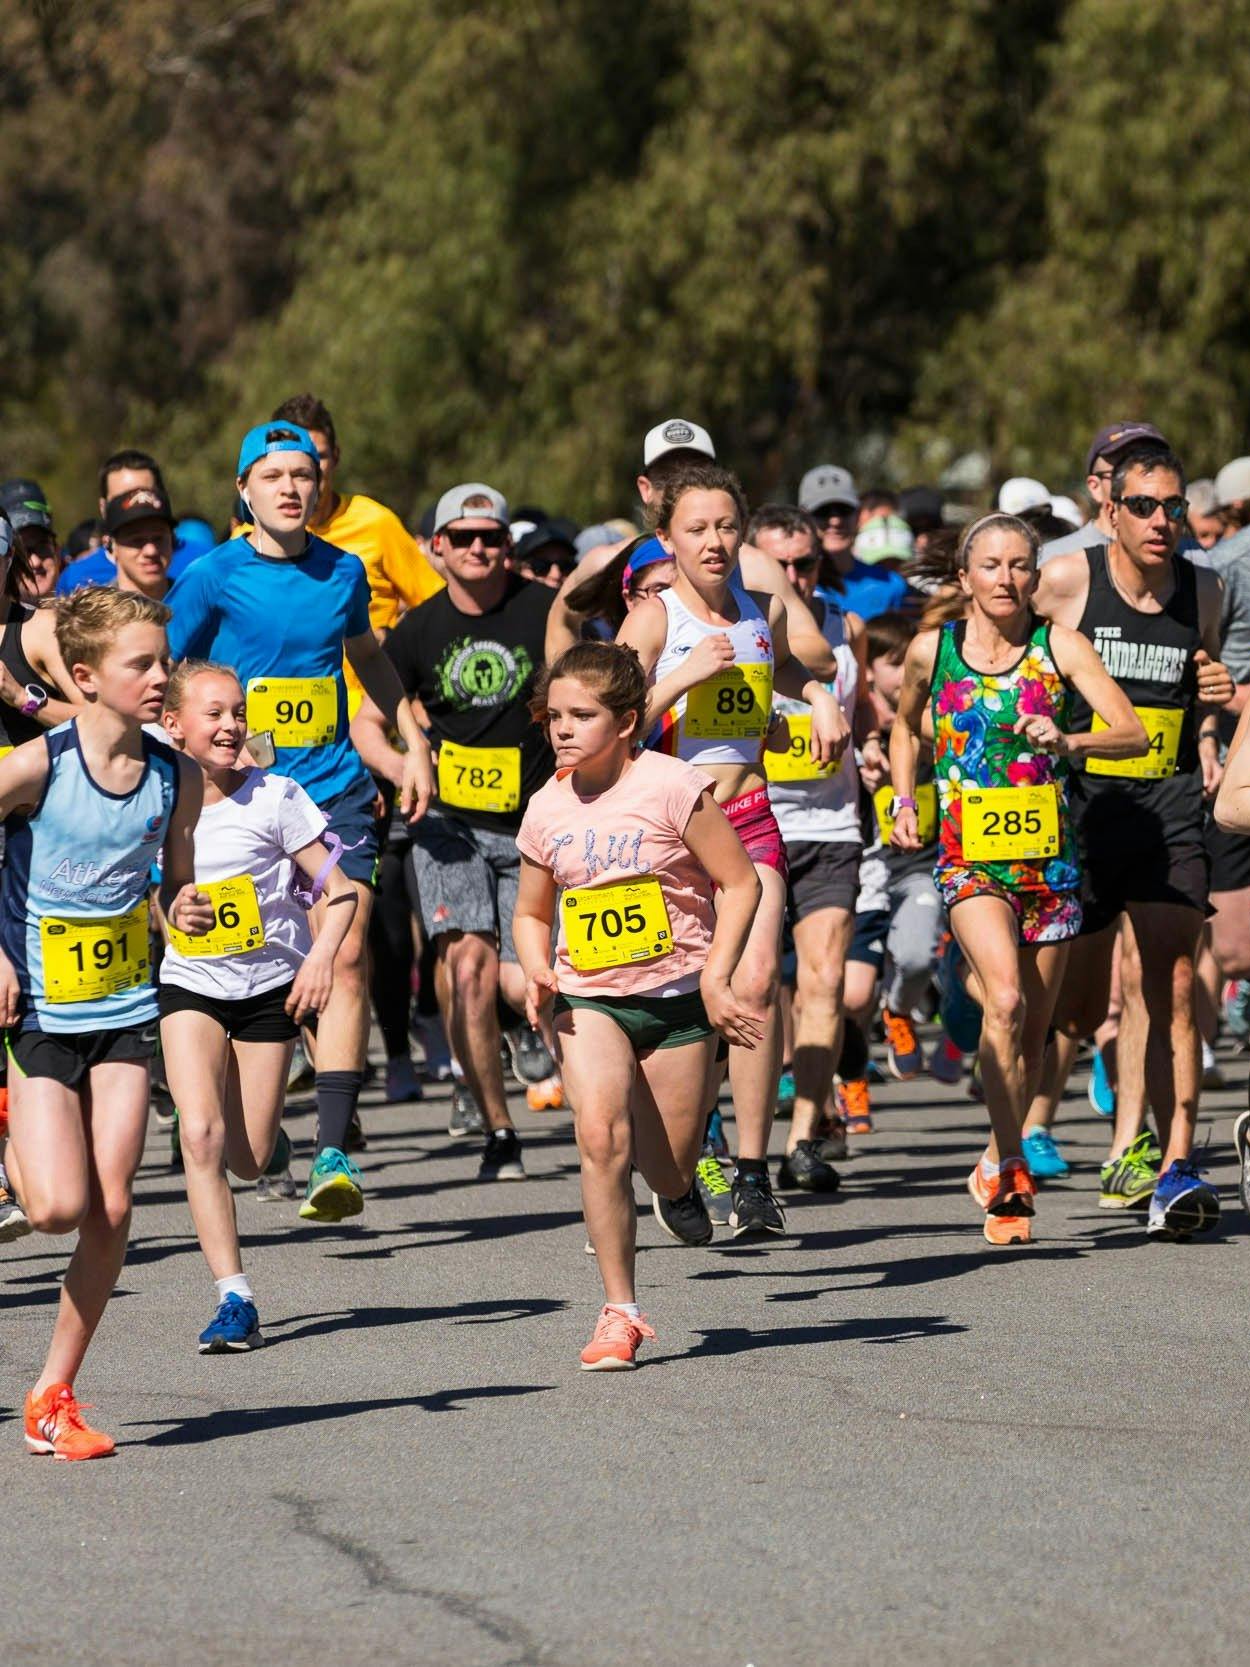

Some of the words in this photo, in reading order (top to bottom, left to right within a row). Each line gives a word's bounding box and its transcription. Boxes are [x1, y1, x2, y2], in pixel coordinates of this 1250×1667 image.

[1094, 627, 1122, 639] THE
[276, 700, 313, 724] 90
[716, 687, 755, 714] 89
[454, 764, 503, 790] 782
[721, 796, 752, 816] NIKE
[983, 809, 1042, 836] 285
[579, 904, 646, 941] 705
[69, 933, 128, 972] 191
